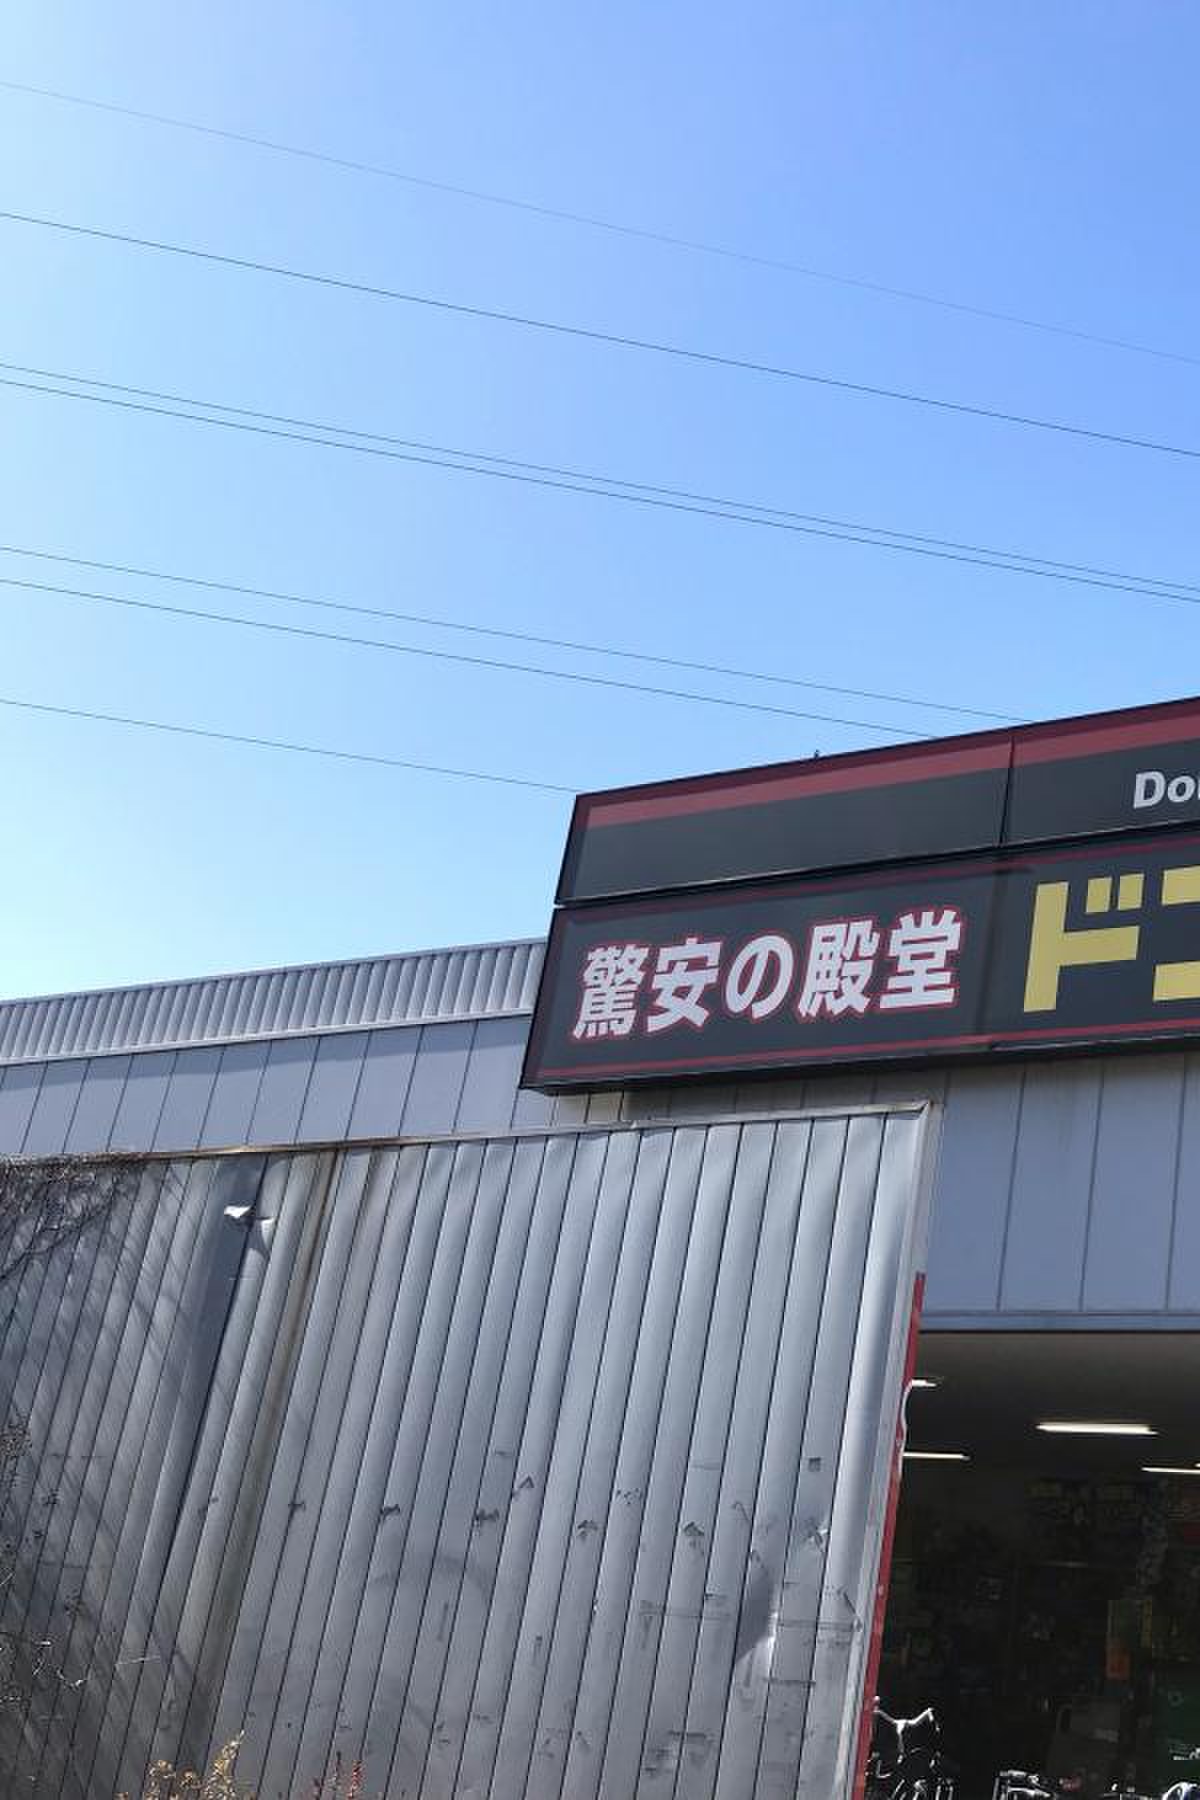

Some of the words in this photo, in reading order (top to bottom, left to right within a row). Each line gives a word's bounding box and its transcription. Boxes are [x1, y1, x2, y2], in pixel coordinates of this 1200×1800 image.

[572, 909, 963, 1040] 驚安の殿堂
